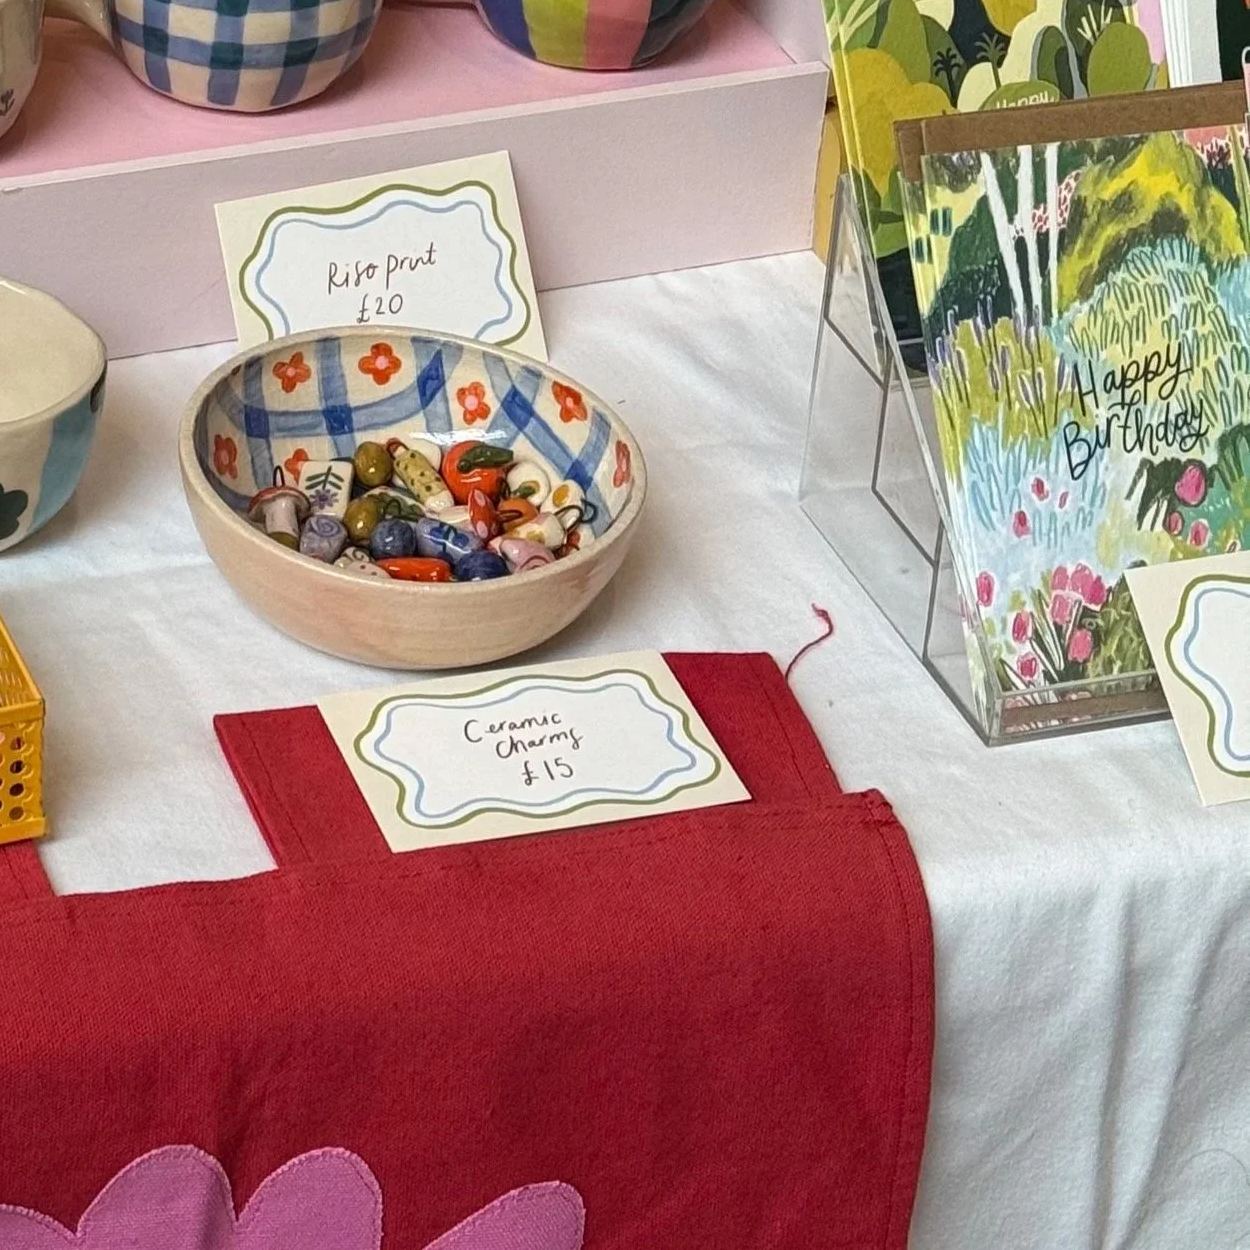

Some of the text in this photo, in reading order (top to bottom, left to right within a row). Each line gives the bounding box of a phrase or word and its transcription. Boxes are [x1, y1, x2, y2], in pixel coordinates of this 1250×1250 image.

[328, 241, 437, 295] Riso print
[356, 293, 404, 324] £20
[1073, 342, 1193, 417] Happy
[1063, 390, 1210, 481] Birthday
[463, 709, 562, 743] Ceramic
[521, 757, 574, 787] £15
